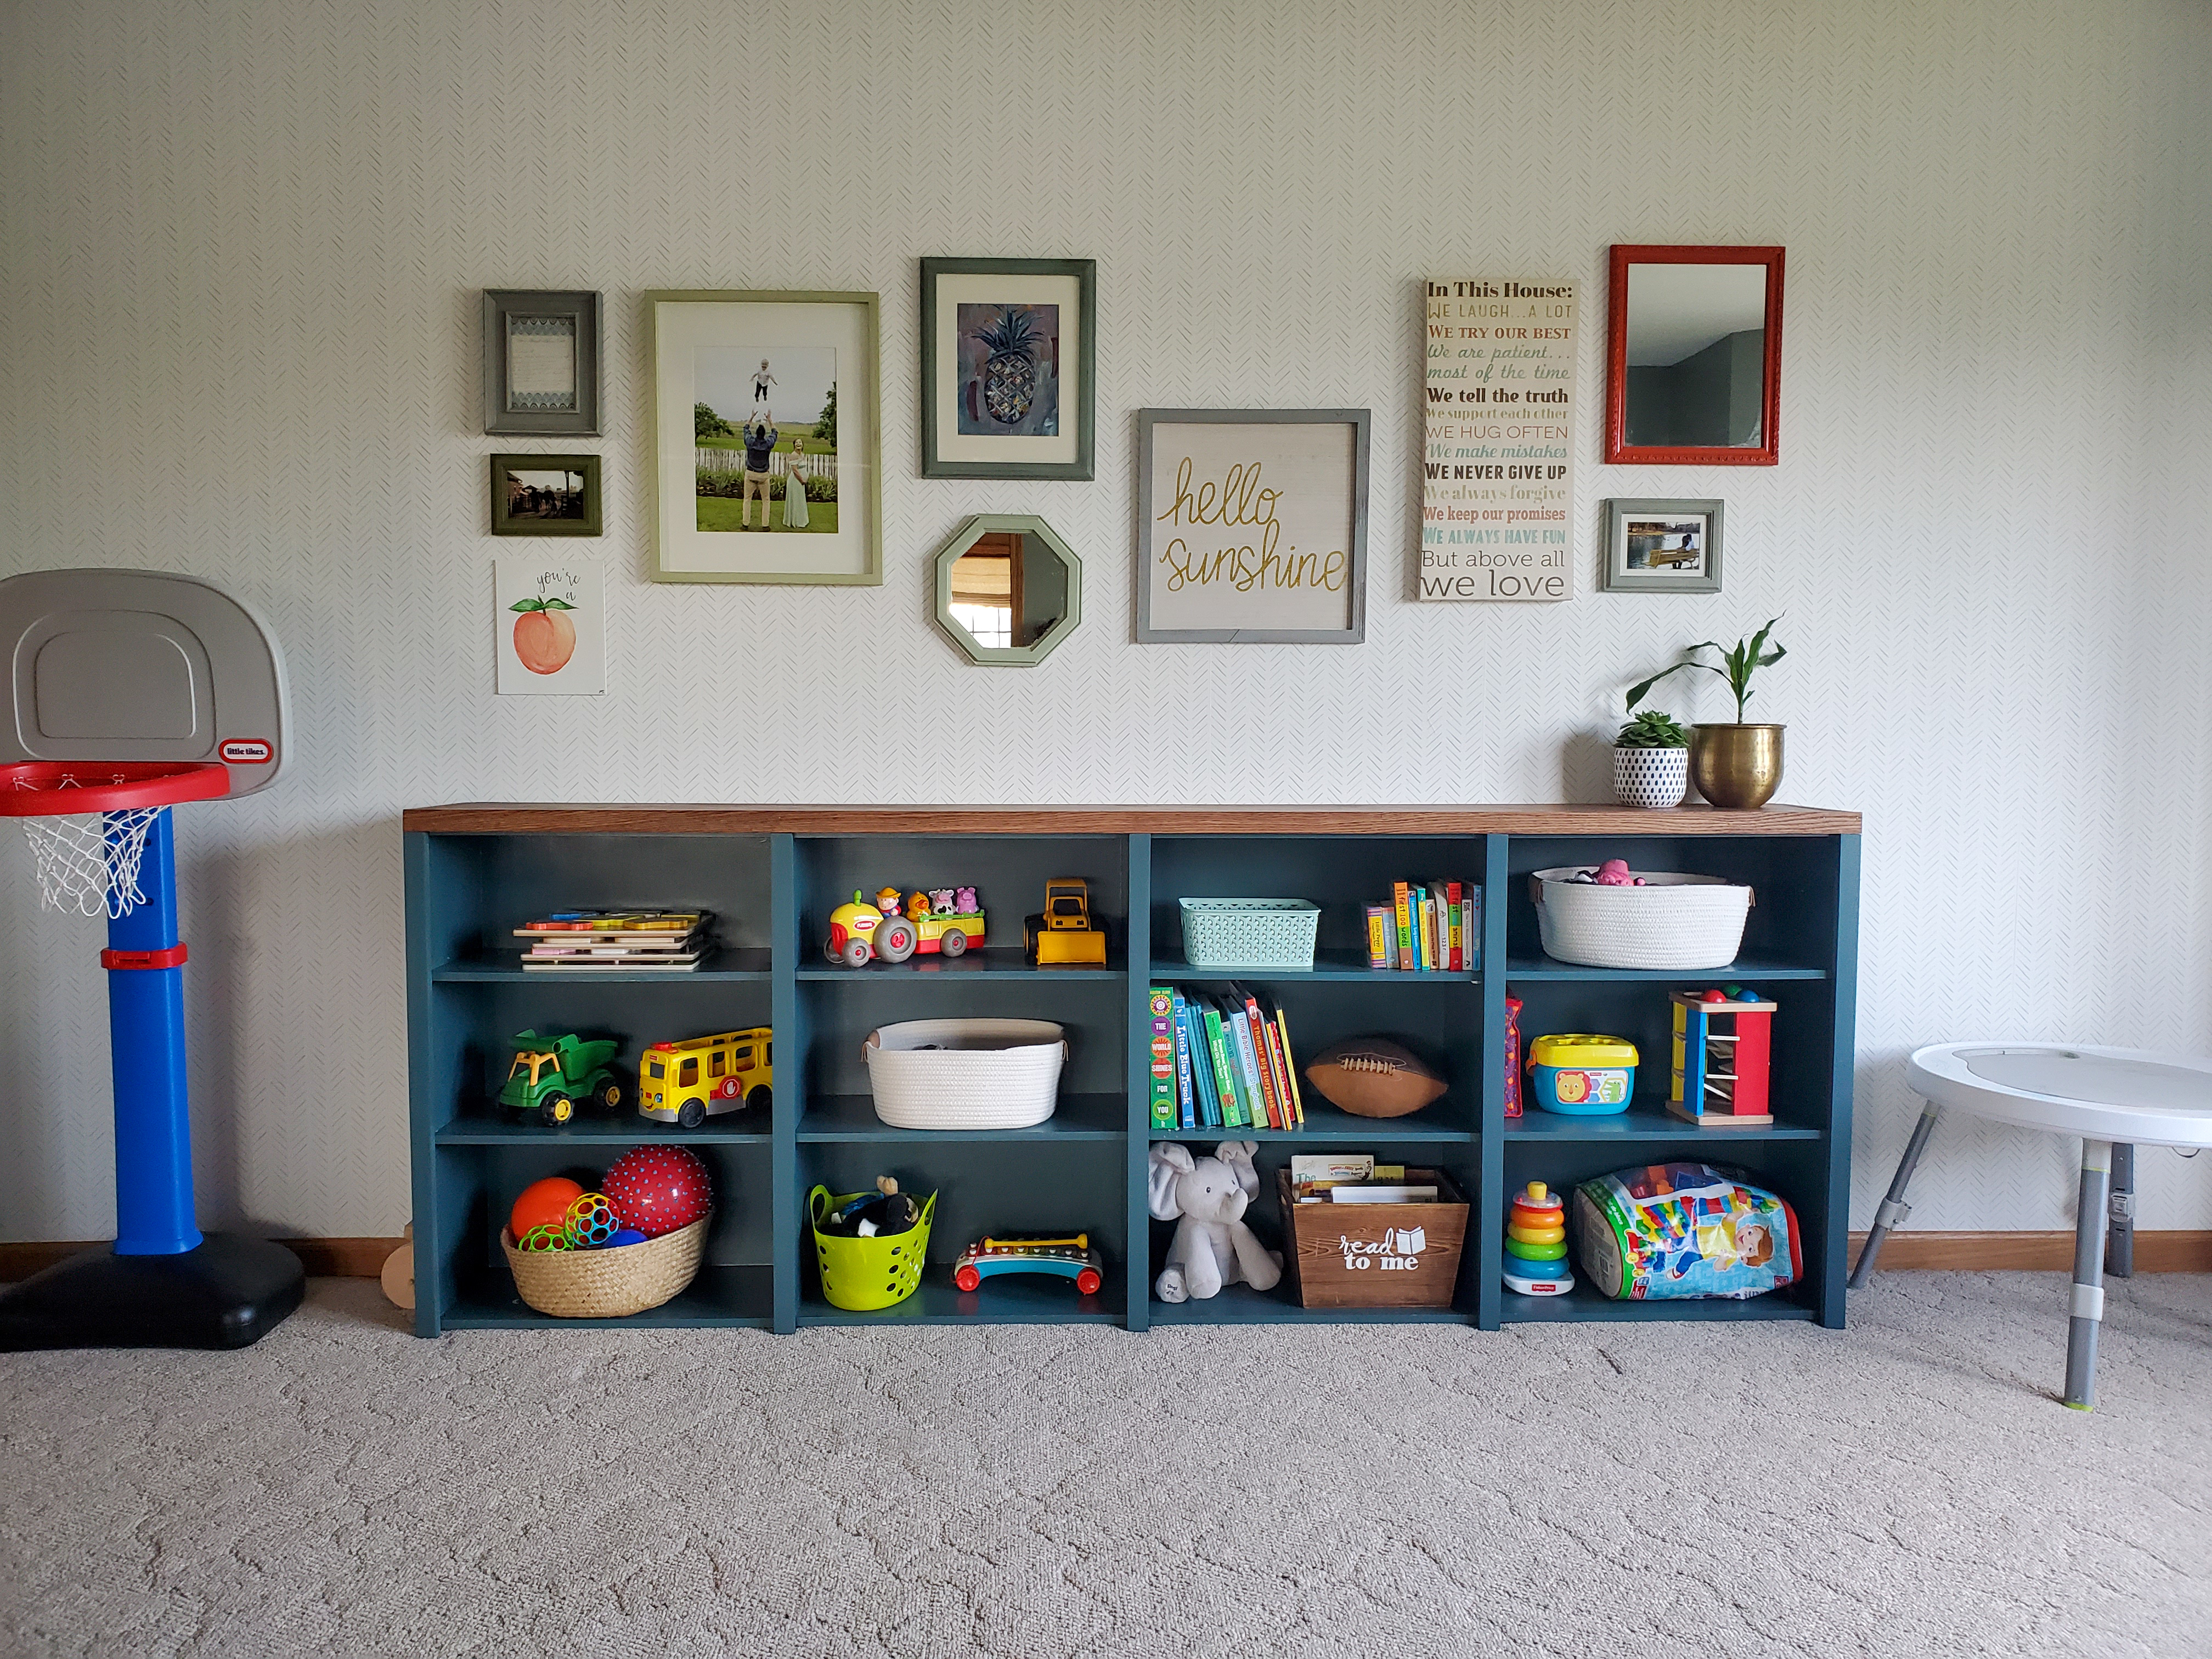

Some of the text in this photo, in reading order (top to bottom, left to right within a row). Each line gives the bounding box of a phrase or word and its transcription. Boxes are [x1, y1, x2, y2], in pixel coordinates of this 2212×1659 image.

[1428, 281, 1572, 298] In This House:
[1428, 302, 1451, 319] WE
[1546, 304, 1572, 318] LOT
[1428, 325, 1571, 340] WE TRY OUR BEST
[1427, 344, 1450, 358] We
[1458, 348, 1486, 358] are
[1426, 363, 1571, 384] most of the time
[1427, 387, 1569, 403] We tell the truth
[1426, 408, 1569, 421] We support each other
[1426, 425, 1568, 439] WE HUG OFTEN
[1426, 443, 1567, 459] We make mistakes
[1425, 462, 1567, 480] WE NEVER GIVE UP
[1156, 456, 1284, 527] hello
[1424, 484, 1566, 504] We always forgive
[1423, 505, 1566, 524] We keep our promises
[1423, 527, 1566, 545] WE ALWAYS HAVE FUN
[1159, 518, 1349, 592] sunshine
[1421, 550, 1565, 567] But above all
[537, 567, 582, 594] you're
[1420, 569, 1565, 597] we love
[565, 591, 576, 601] a
[1398, 897, 1407, 913] first
[1401, 927, 1409, 947] words
[1155, 1023, 1167, 1031] THE
[1238, 1018, 1246, 1034] Little
[1152, 1043, 1172, 1051] WORLD
[1177, 1025, 1187, 1053] Little
[1241, 1035, 1249, 1050] Bible
[1151, 1064, 1173, 1073] SHINES
[1180, 1053, 1189, 1074] Blue
[1254, 1025, 1265, 1057] Thomas'
[1263, 1070, 1276, 1110] Storybook
[1156, 1085, 1169, 1093] FOR
[1181, 1074, 1192, 1105] Truck
[1249, 1077, 1262, 1111] Storybook
[1156, 1106, 1169, 1114] YOU
[1296, 1172, 1317, 1183] The
[1338, 1227, 1395, 1256] read
[1344, 1252, 1420, 1271] to me
